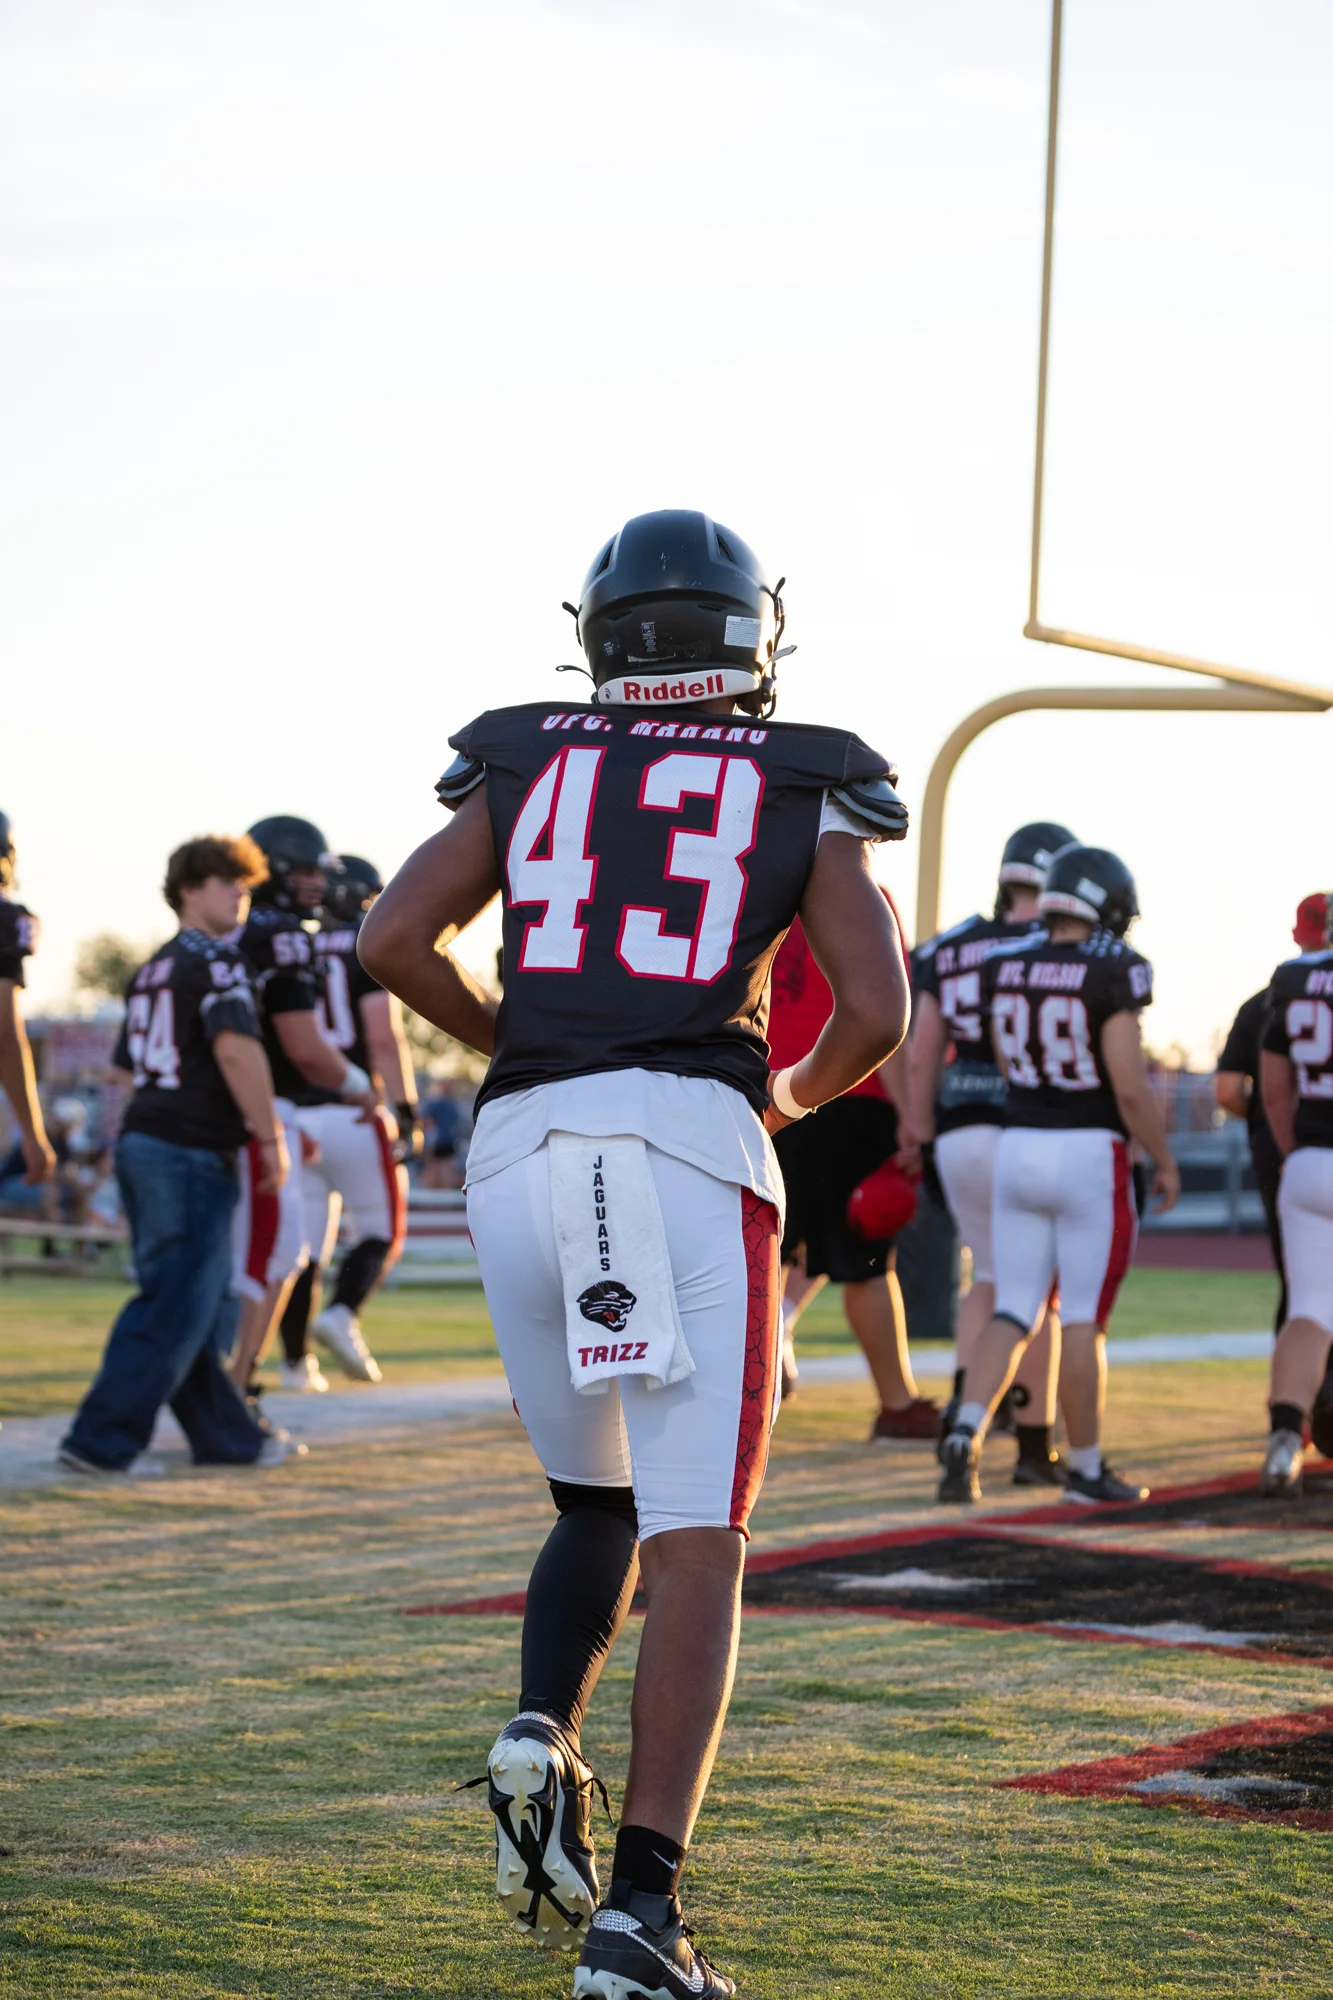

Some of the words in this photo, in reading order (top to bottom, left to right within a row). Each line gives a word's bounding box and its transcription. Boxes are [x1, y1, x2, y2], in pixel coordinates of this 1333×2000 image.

[623, 673, 724, 701] Riddell
[505, 745, 767, 986] 43
[593, 1155, 611, 1272] JAGUARS
[577, 1341, 649, 1368] TRIZZ
